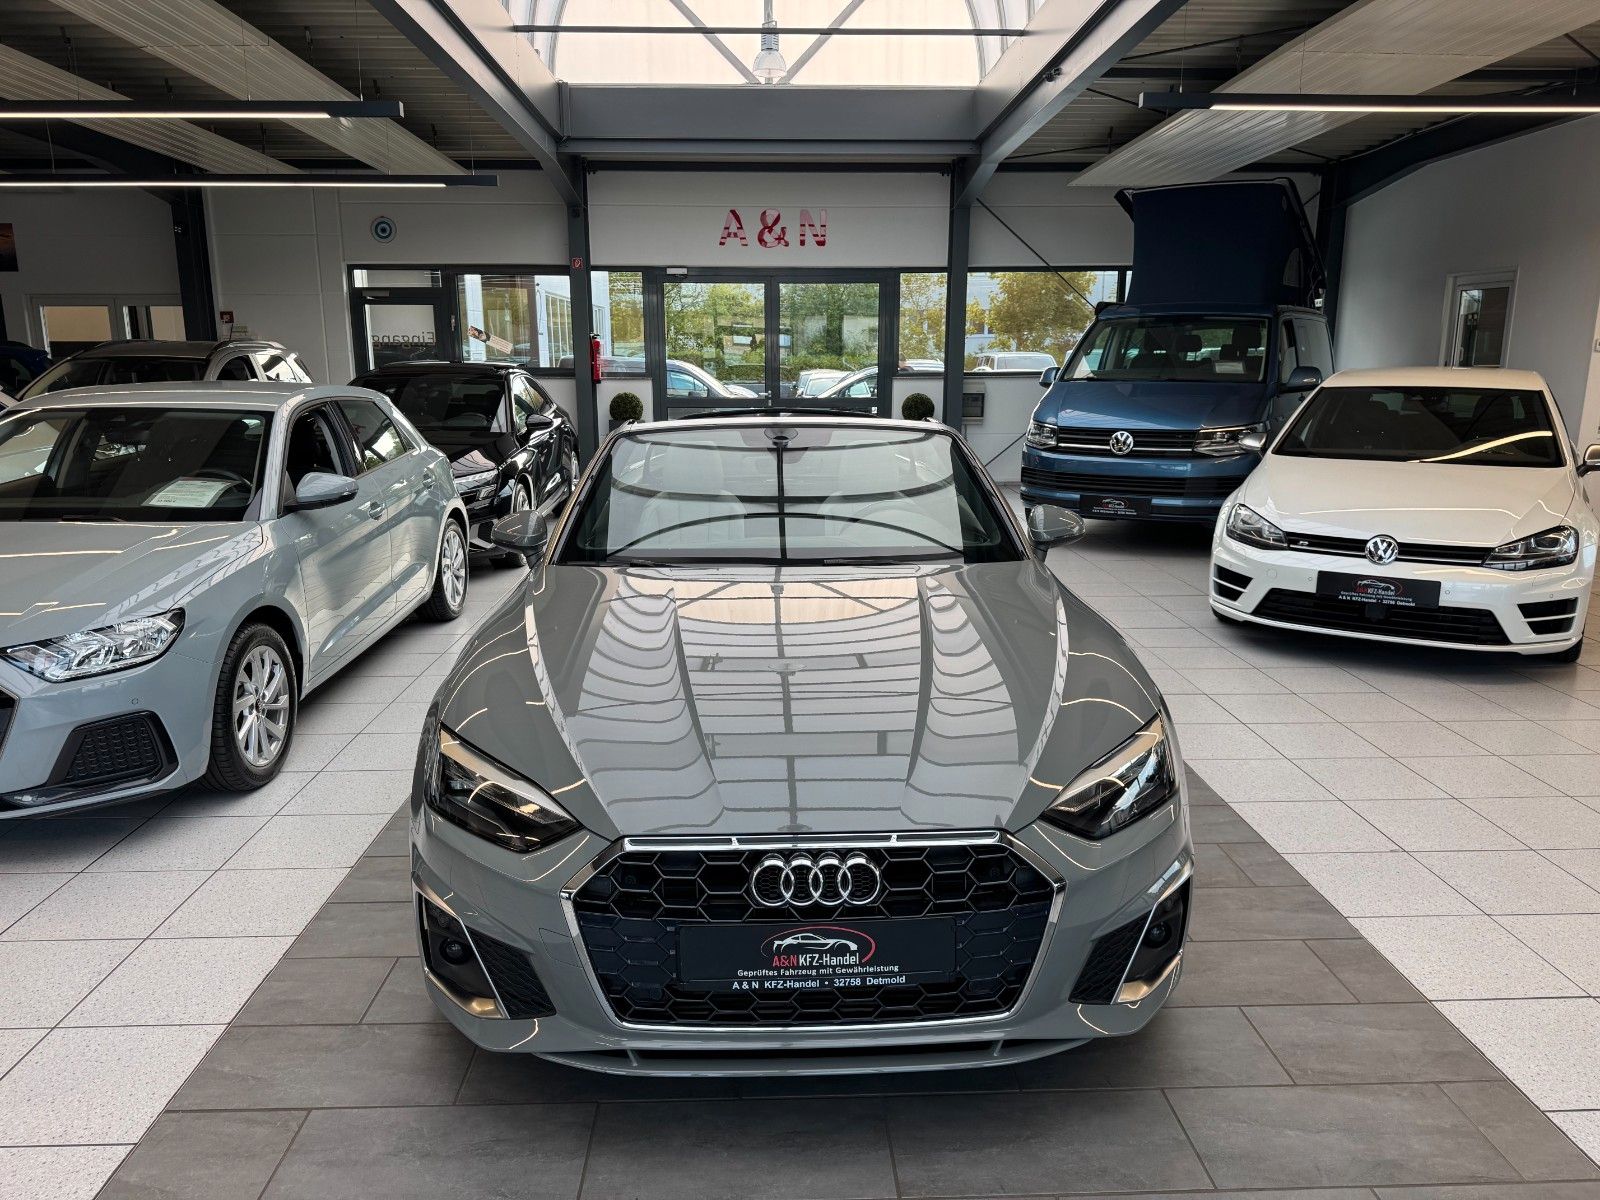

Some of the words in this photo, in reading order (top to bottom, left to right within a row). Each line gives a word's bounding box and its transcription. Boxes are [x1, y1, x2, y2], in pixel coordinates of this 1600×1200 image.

[772, 954, 797, 968] A&N
[799, 953, 860, 967] KFZ-Handel
[737, 968, 778, 978] Geprüftes
[780, 967, 817, 977] Fahrzeug
[819, 966, 833, 975] mit
[835, 964, 899, 974] Gewährleistung
[732, 981, 740, 990] A
[742, 981, 750, 989] &
[751, 980, 759, 989] N
[764, 979, 820, 989] KFZ-Handel
[833, 977, 861, 986] 32758
[866, 975, 906, 986] Detmold
